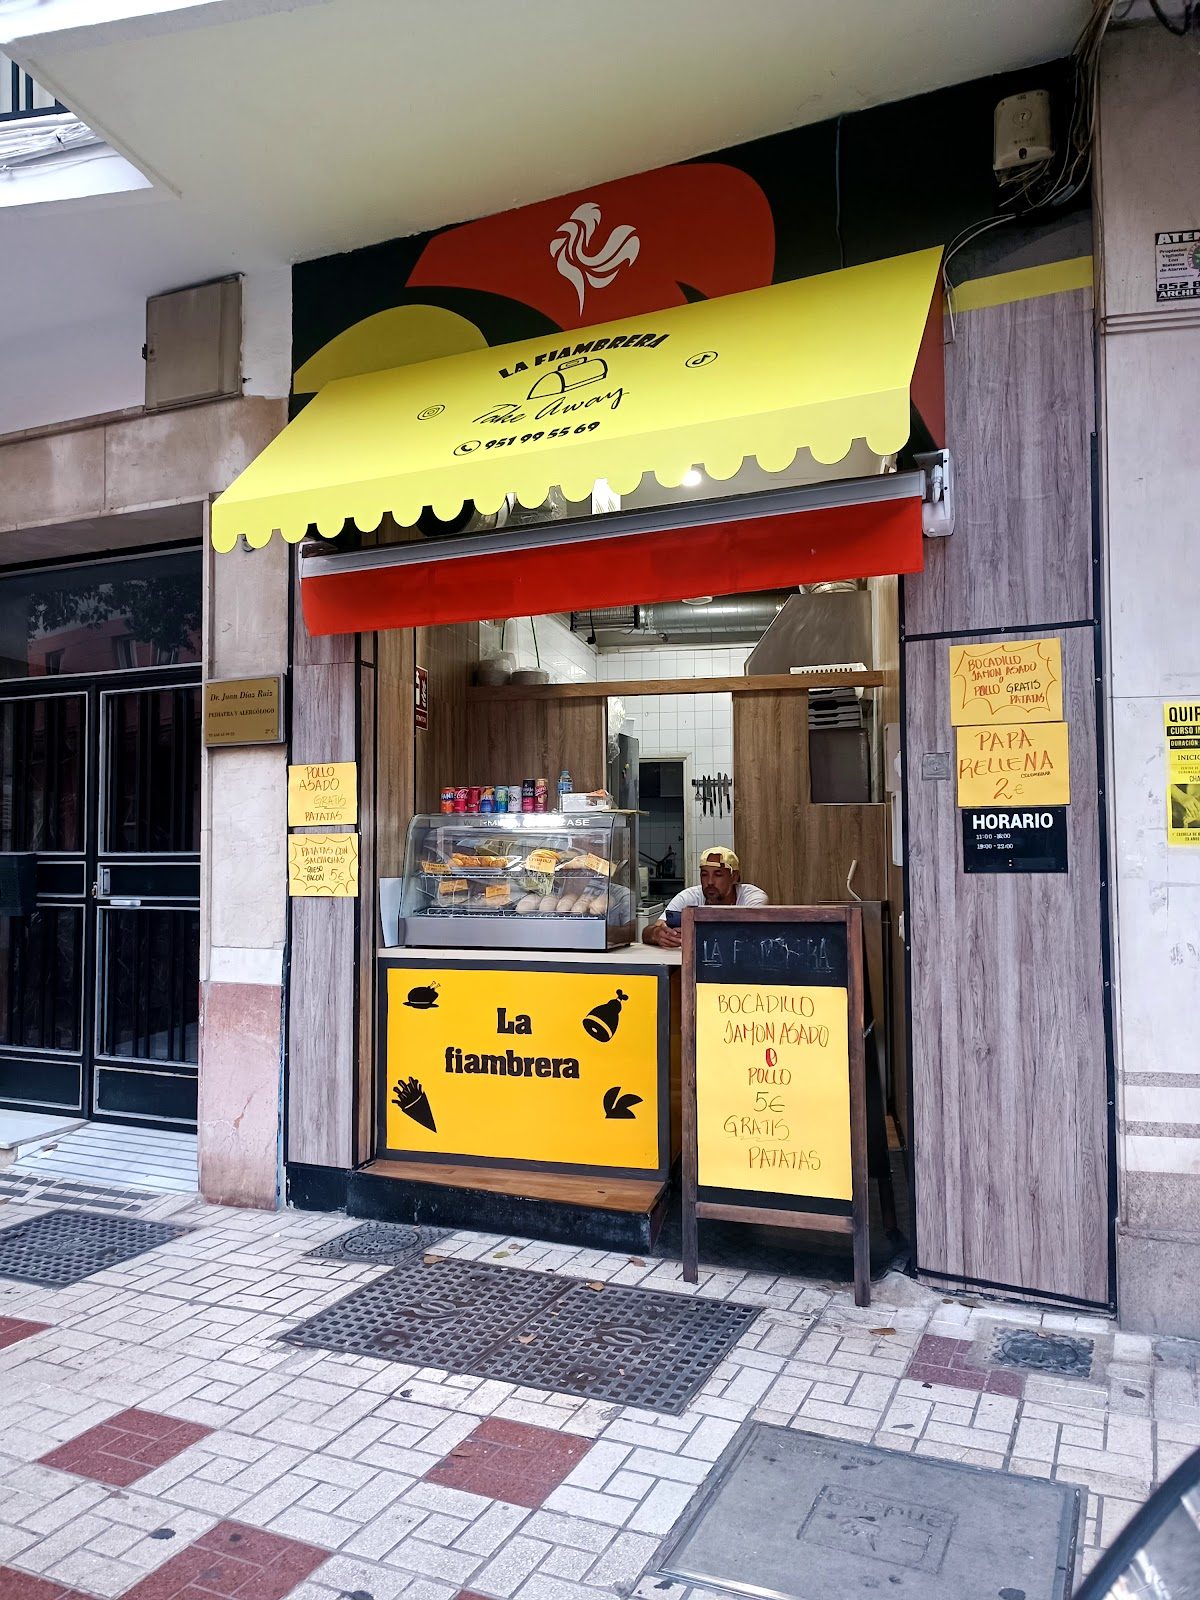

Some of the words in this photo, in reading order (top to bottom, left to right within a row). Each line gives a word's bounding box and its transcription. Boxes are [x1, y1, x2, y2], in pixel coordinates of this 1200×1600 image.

[1158, 281, 1189, 290] 952
[498, 361, 529, 379] LA
[534, 333, 671, 366] FIAMBRERA
[472, 403, 527, 424] Take
[534, 387, 631, 420] Away
[484, 435, 517, 450] 951
[520, 431, 545, 443] 99
[546, 426, 571, 439] 55
[573, 421, 601, 434] 69
[968, 655, 1021, 672] BOCADILLO
[971, 667, 1002, 681] JAMON
[1005, 662, 1037, 676] ASADO
[210, 693, 220, 701] Dr.
[221, 692, 238, 702] Juan
[257, 689, 273, 698] Ruiz
[973, 684, 1001, 696] POLLO
[1006, 679, 1041, 694] GRATIS
[1009, 692, 1045, 705] PATATAS
[208, 710, 234, 718] PEDIATRA
[975, 728, 1035, 751] PAPA
[1170, 726, 1194, 735] CURSO
[304, 766, 335, 780] POLLO
[959, 750, 1054, 779] RELLENA
[299, 778, 340, 791] ASADO
[313, 794, 347, 807] GRATIS
[304, 811, 343, 822] PATATAS
[972, 812, 1054, 830] HORARIO
[301, 846, 334, 856] PATATAS
[335, 845, 348, 855] CON
[718, 992, 815, 1018] BOCADILLO
[496, 1007, 533, 1035] La
[723, 1020, 775, 1046] JAMON
[778, 1021, 830, 1047] ASADO
[444, 1046, 580, 1079] fiambrera
[748, 1067, 792, 1086] POLLO
[753, 1091, 786, 1113] 5€
[723, 1114, 790, 1141] GRATIS
[748, 1146, 821, 1171] PATATAS
